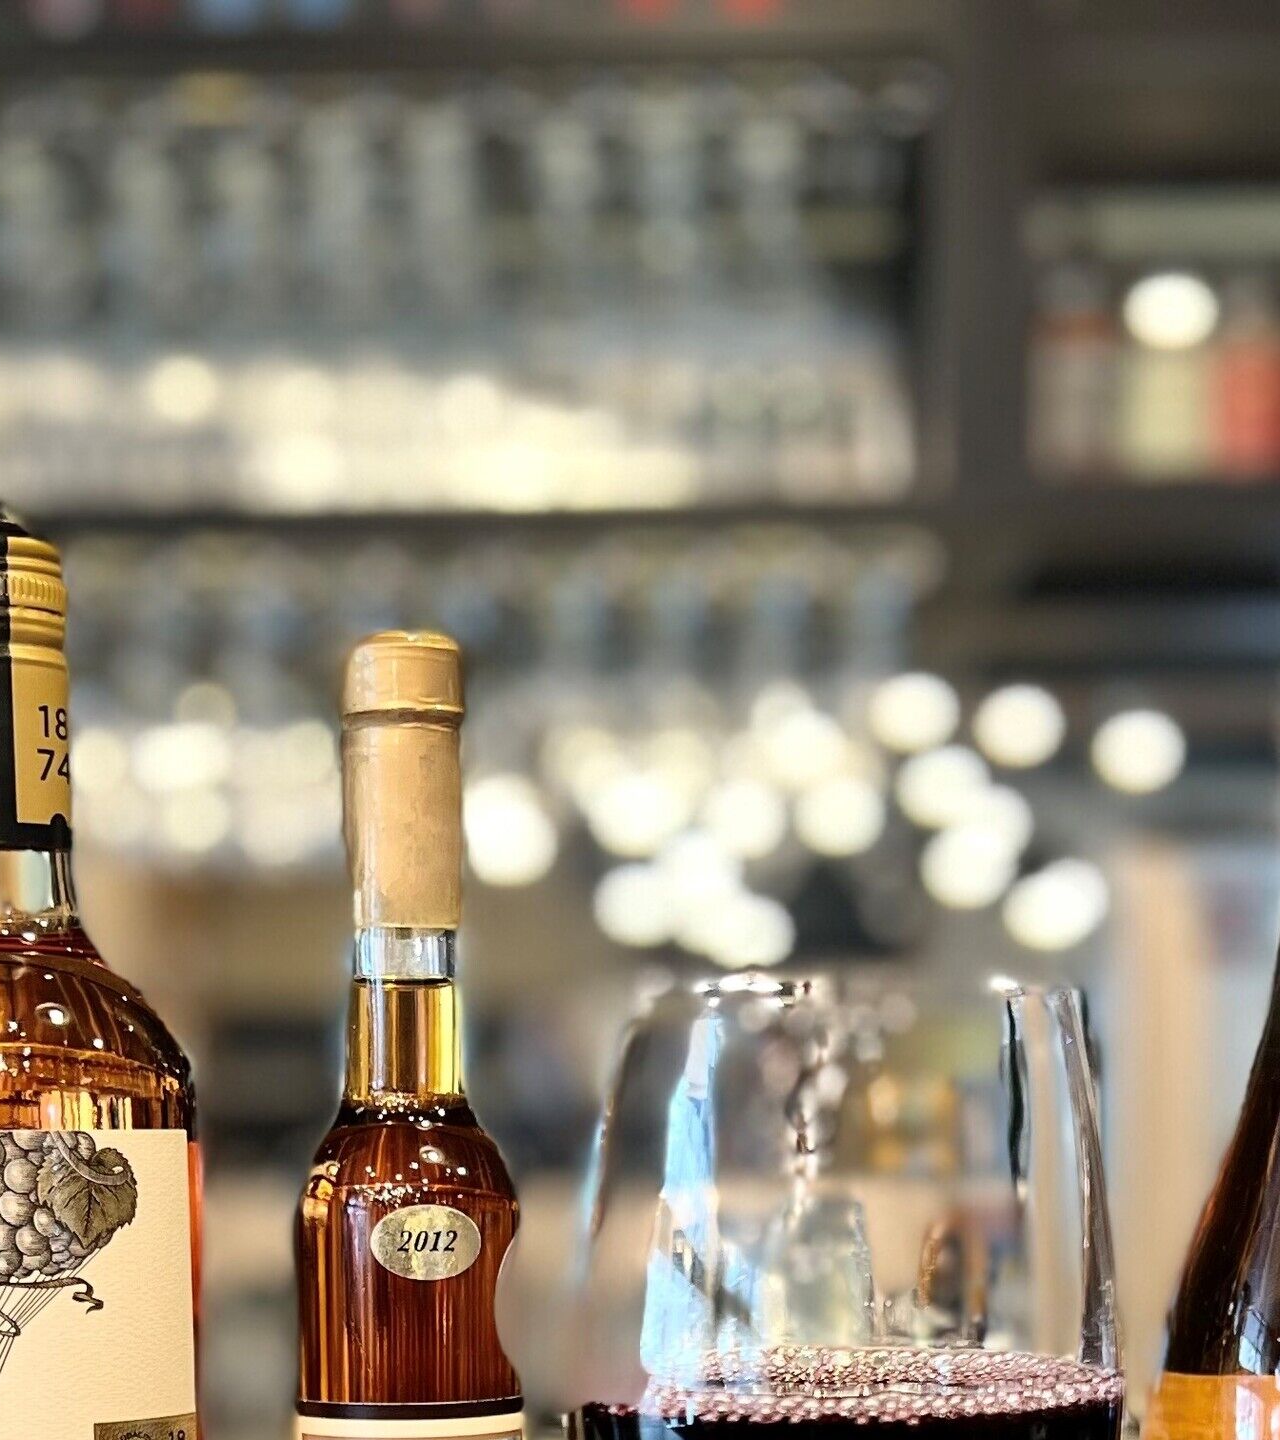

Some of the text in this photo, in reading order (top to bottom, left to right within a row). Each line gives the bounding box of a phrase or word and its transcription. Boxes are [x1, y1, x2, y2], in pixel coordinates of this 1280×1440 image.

[37, 705, 68, 741] 18
[36, 748, 71, 785] 74
[397, 1230, 458, 1253] 2012
